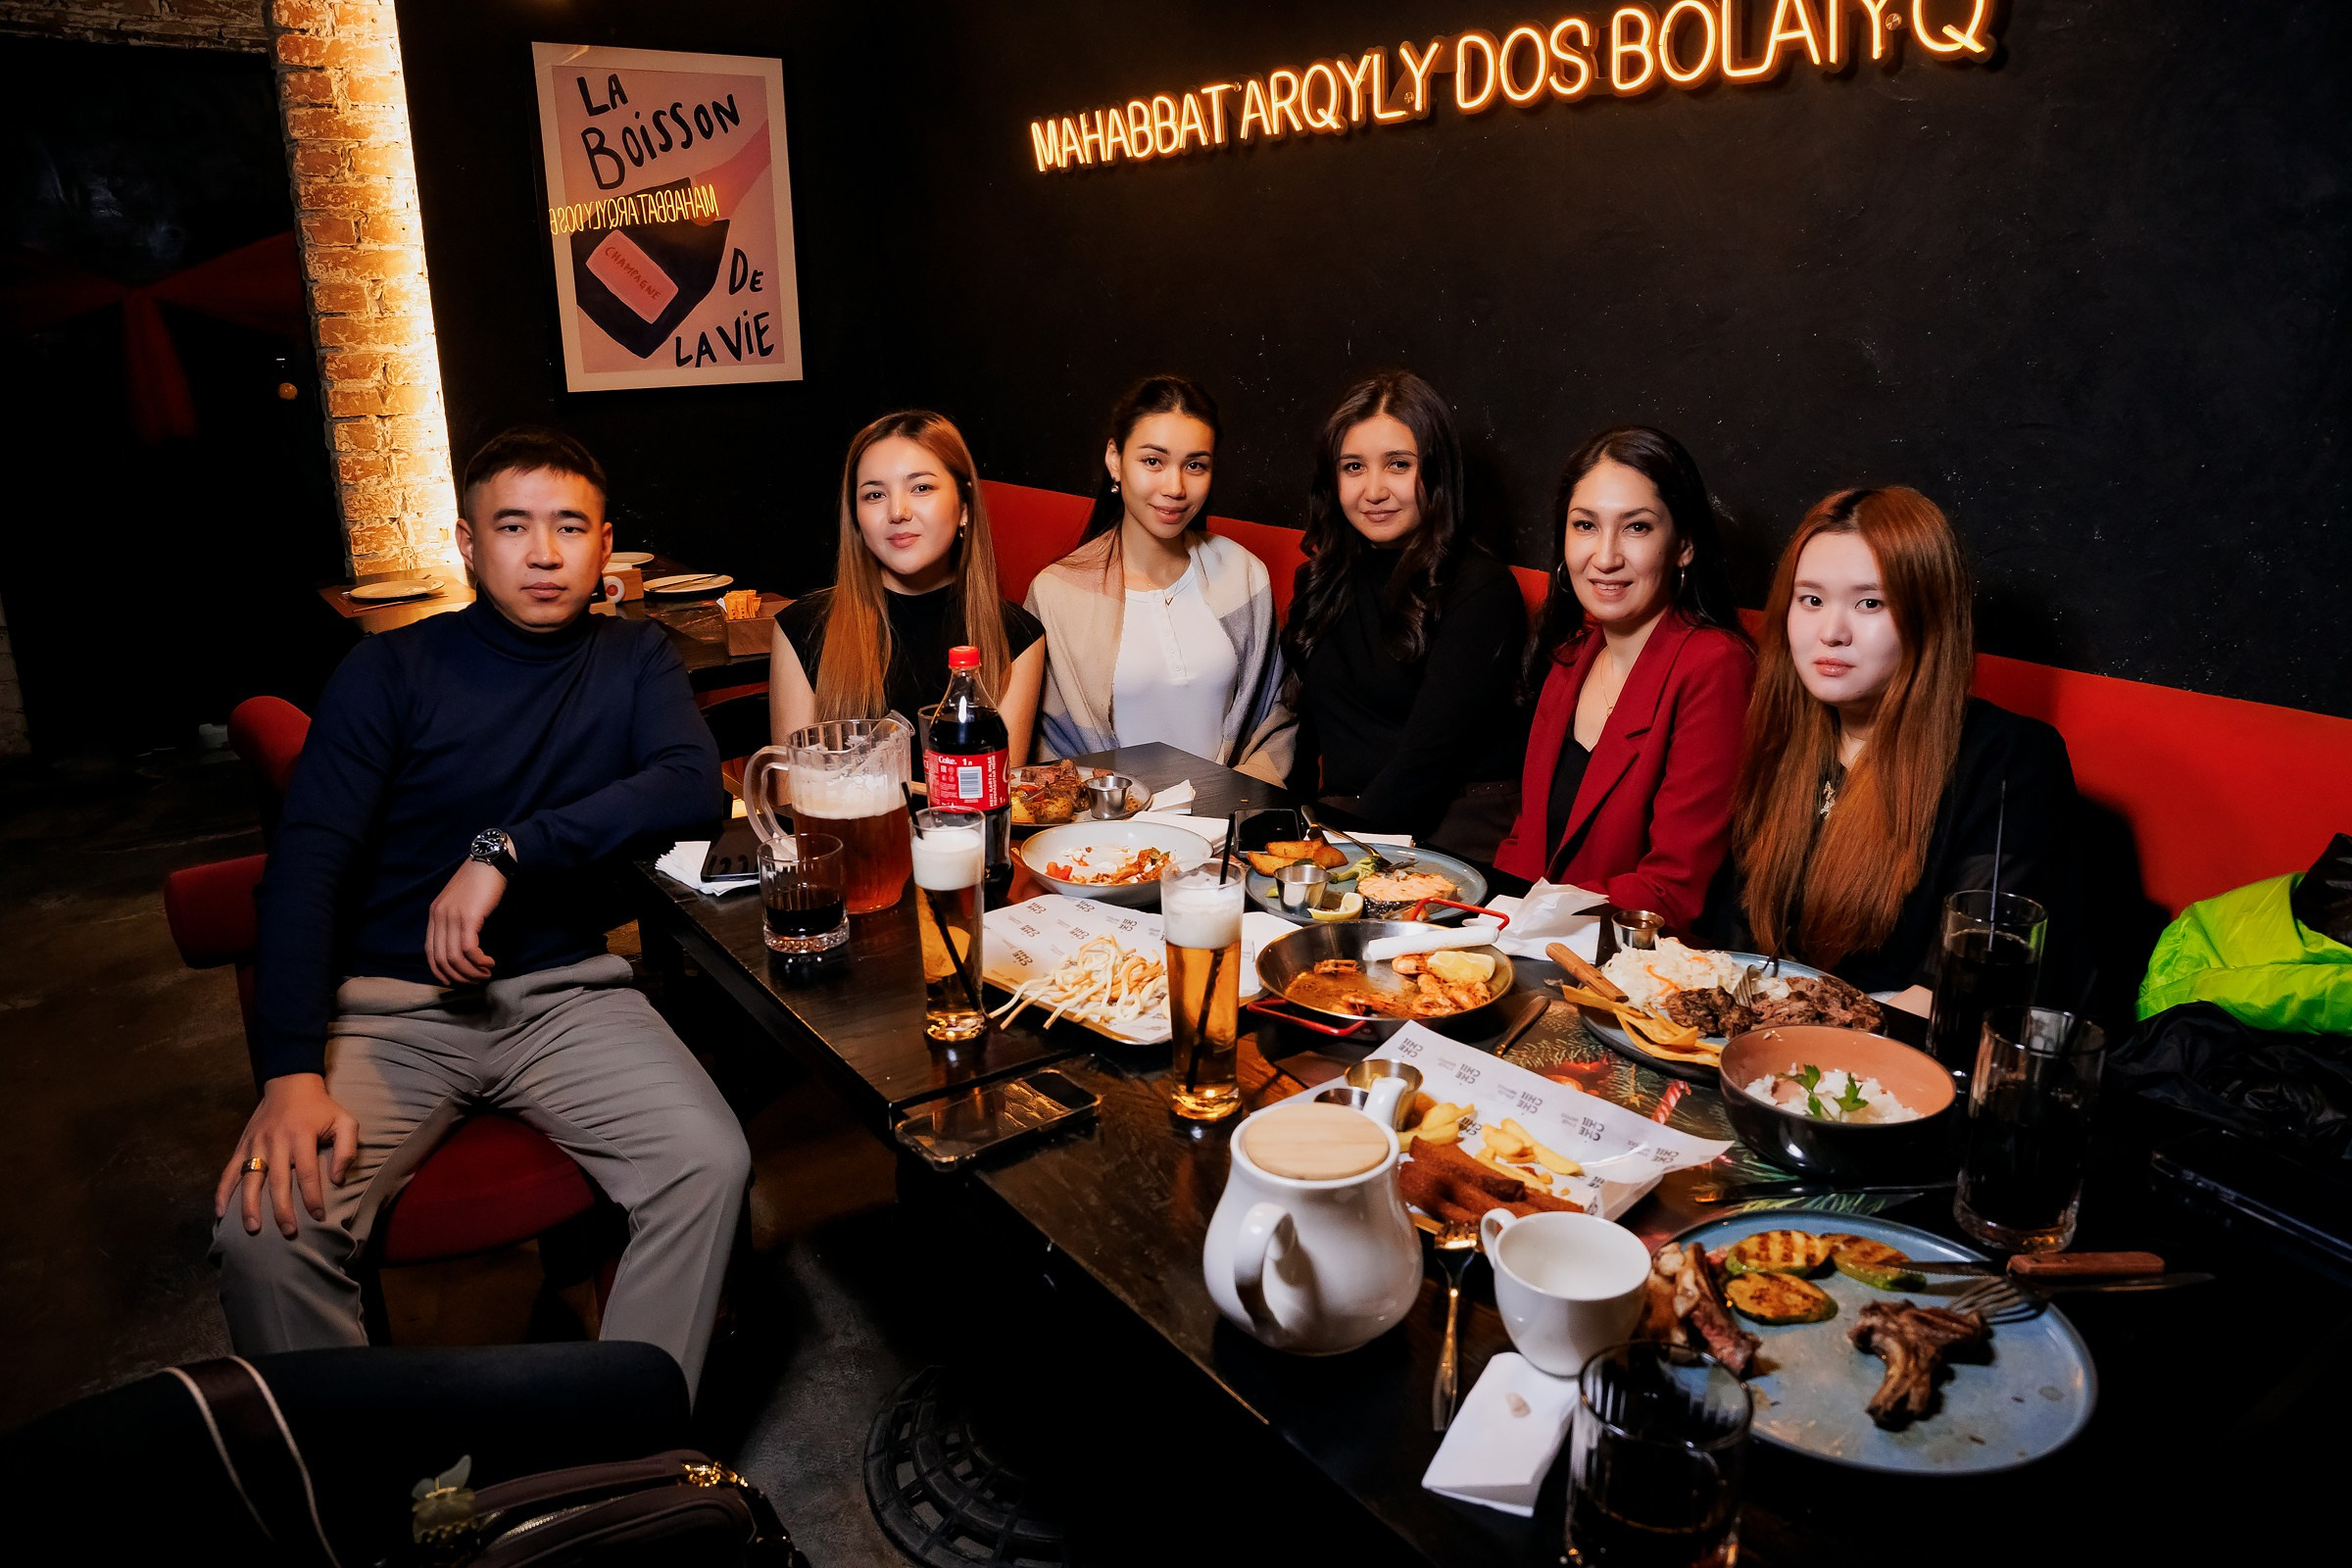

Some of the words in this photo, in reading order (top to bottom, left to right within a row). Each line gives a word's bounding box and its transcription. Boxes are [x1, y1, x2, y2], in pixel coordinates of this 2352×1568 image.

[576, 74, 628, 117] LA
[1031, 83, 1236, 172] MAHABBAT
[1240, 41, 1441, 140] ARQYLY
[1456, 19, 1592, 109] DOS
[605, 246, 662, 300] CHAMPAGNE
[729, 247, 763, 295] DE
[674, 331, 717, 368] LA
[1397, 1045, 1417, 1058] CHE
[1454, 1070, 1476, 1084] CHE
[1516, 1099, 1538, 1114] CHE
[1578, 1126, 1601, 1142] CHE
